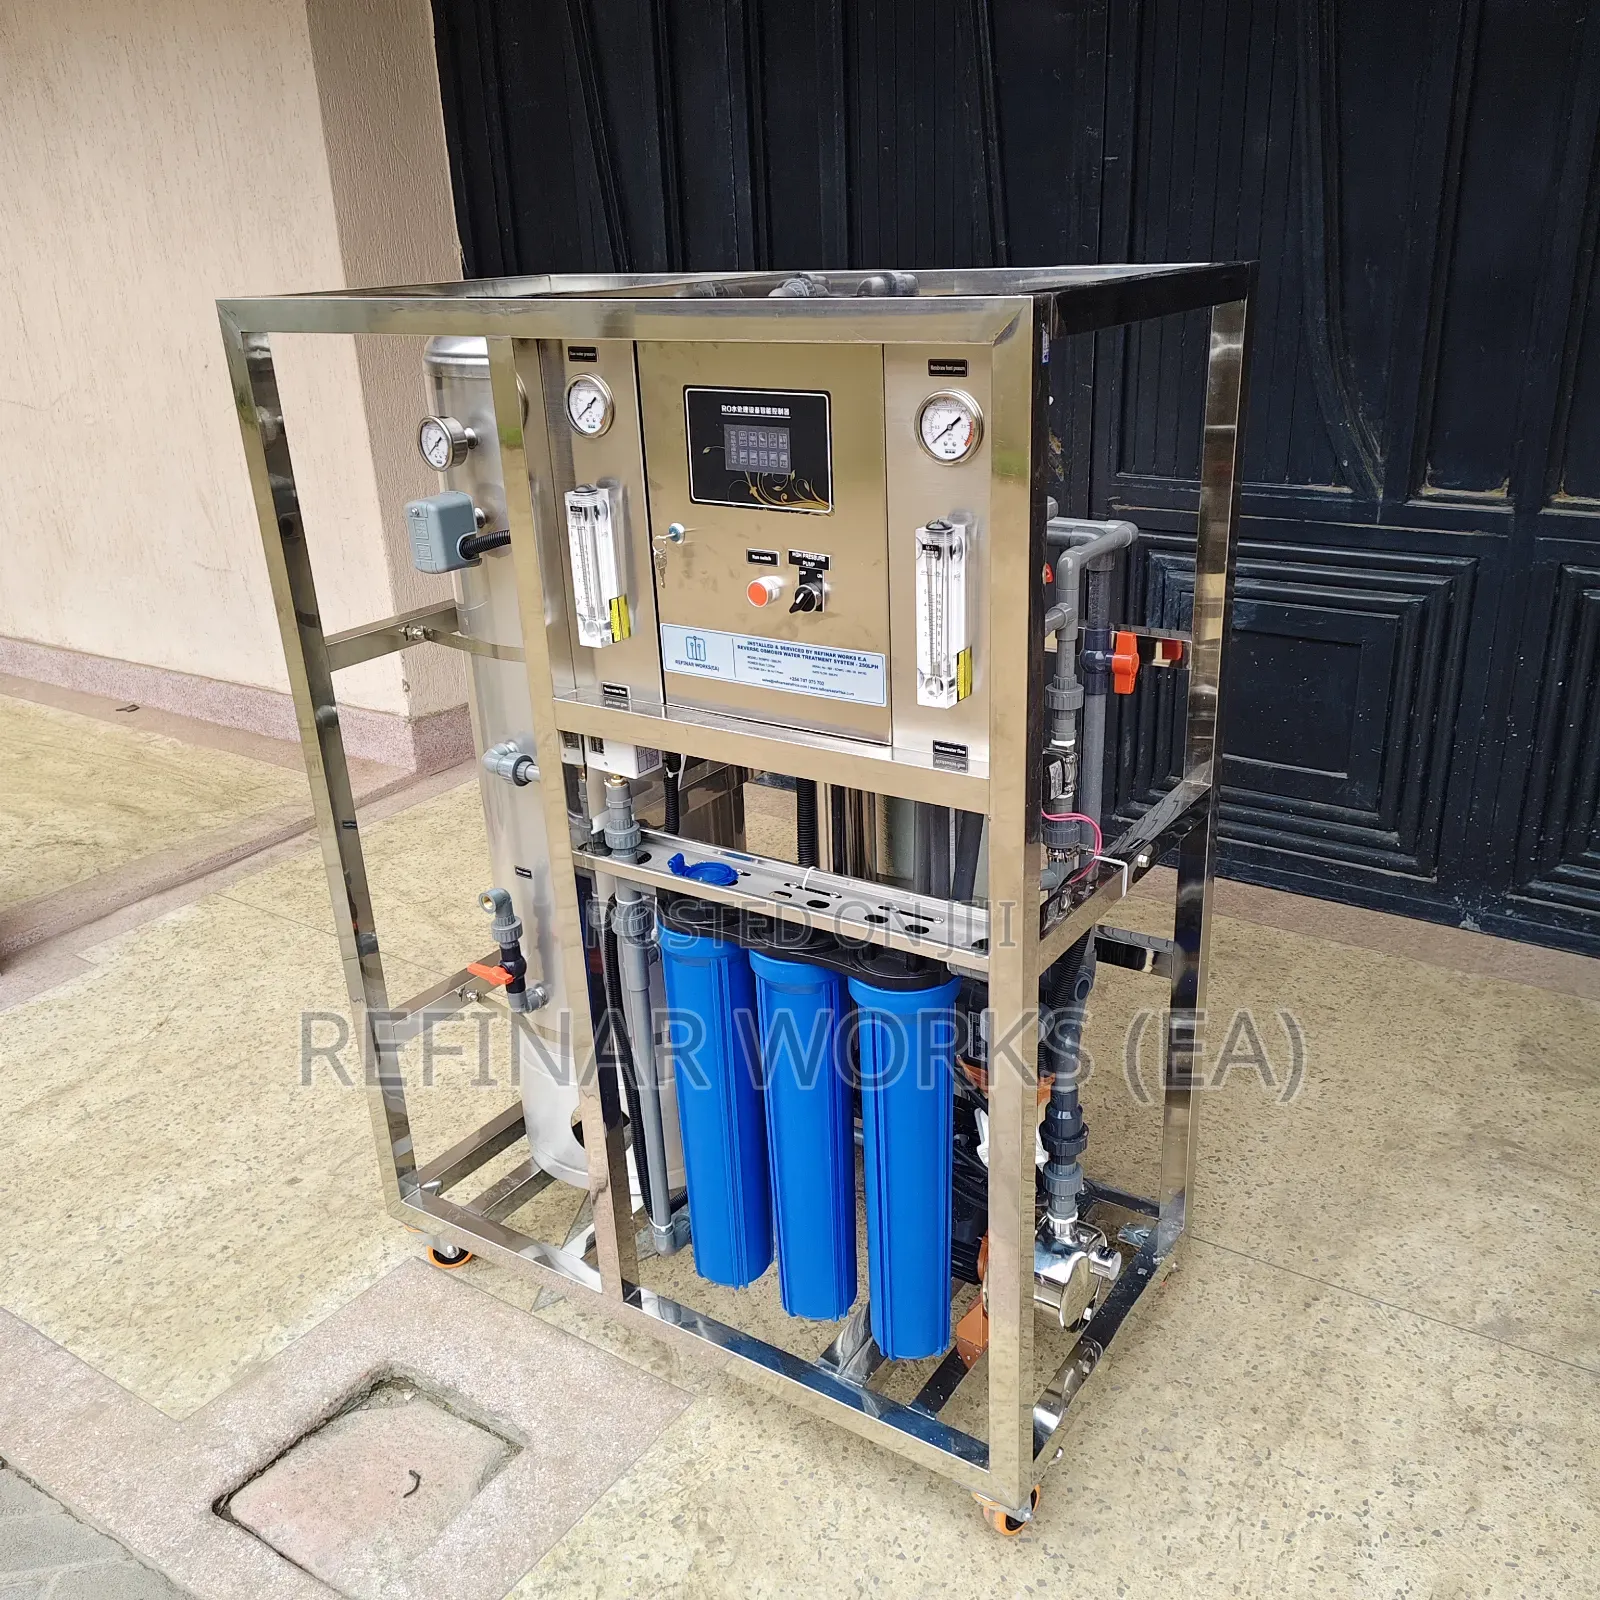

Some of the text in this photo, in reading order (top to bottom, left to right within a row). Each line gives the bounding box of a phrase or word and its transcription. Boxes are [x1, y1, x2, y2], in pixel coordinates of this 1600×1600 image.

[737, 644, 759, 653] REVERSE
[760, 648, 783, 656] OSMOSIS
[802, 654, 832, 663] TREATMENT
[834, 659, 854, 667] SYSTEM
[747, 641, 774, 649] INSTALLED
[780, 645, 804, 654] SERVICED
[814, 650, 836, 658] REFINAR
[675, 659, 694, 667] REFINAR
